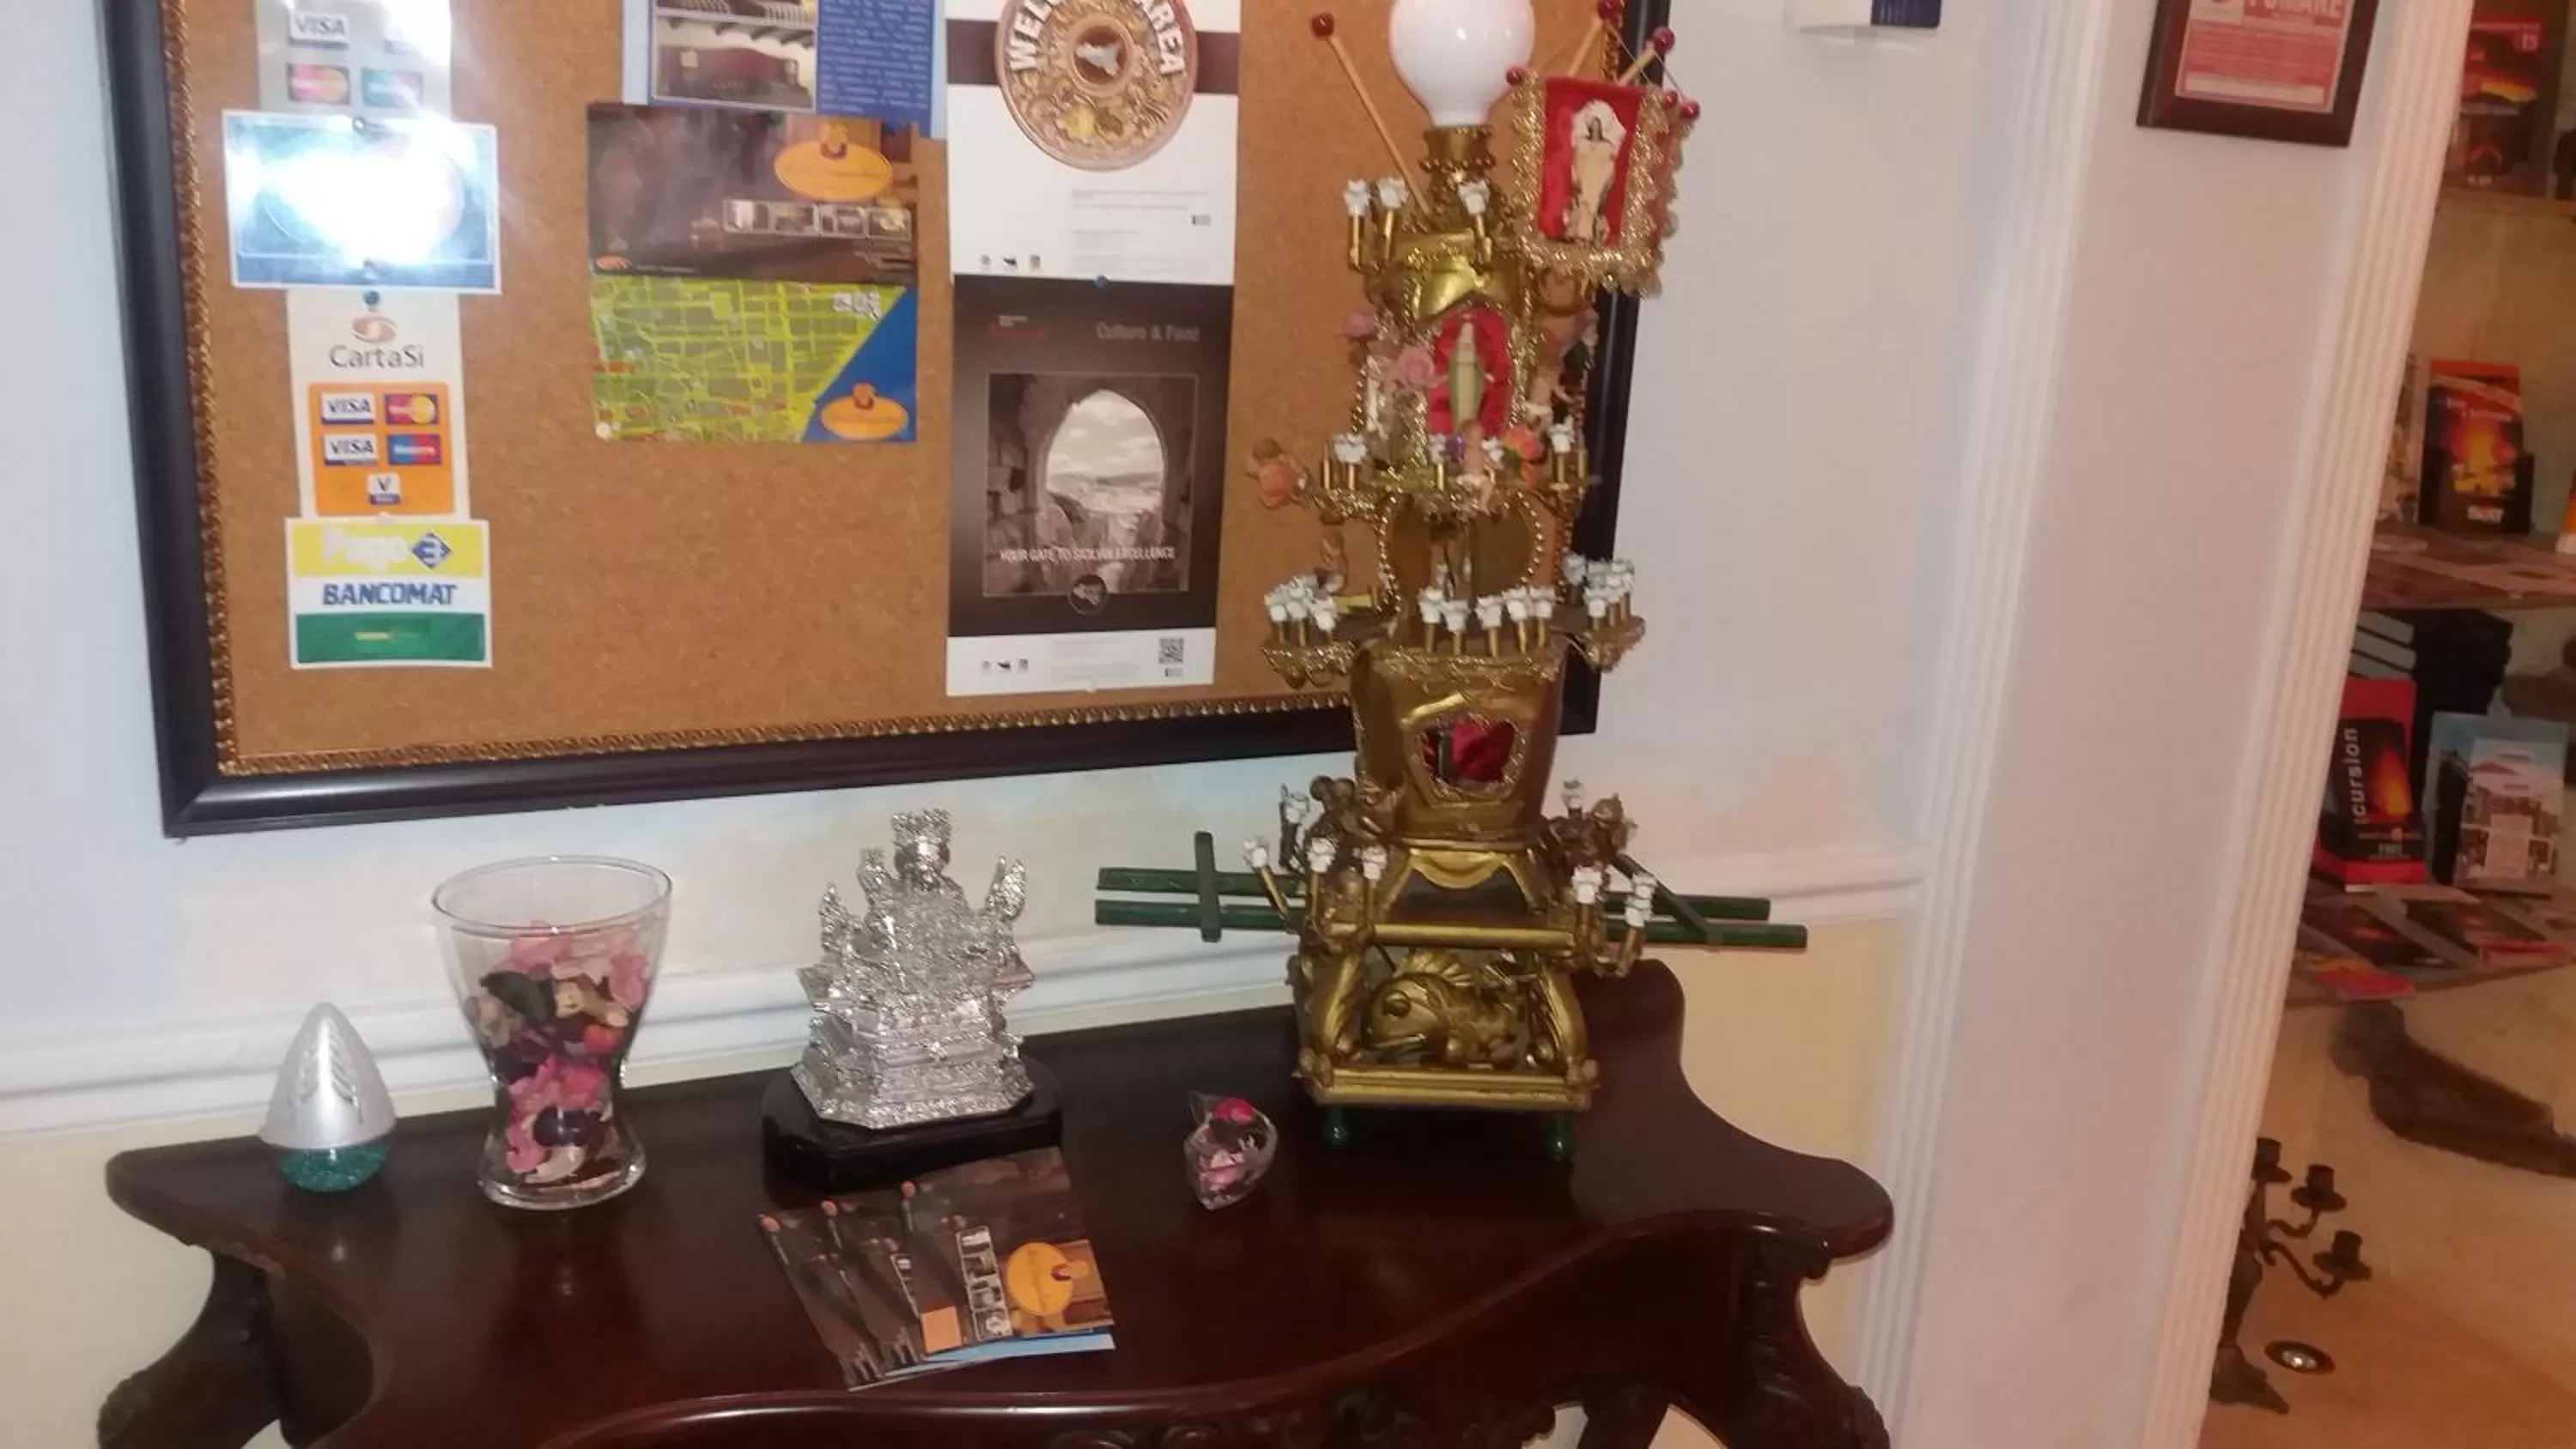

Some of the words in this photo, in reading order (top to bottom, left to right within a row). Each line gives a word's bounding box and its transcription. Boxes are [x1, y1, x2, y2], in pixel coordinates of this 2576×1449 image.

[295, 15, 346, 35] VISA
[329, 344, 425, 368] CartaSi
[326, 397, 372, 414] VISA
[330, 440, 374, 455] VISA
[322, 583, 458, 605] BANCOMAT
